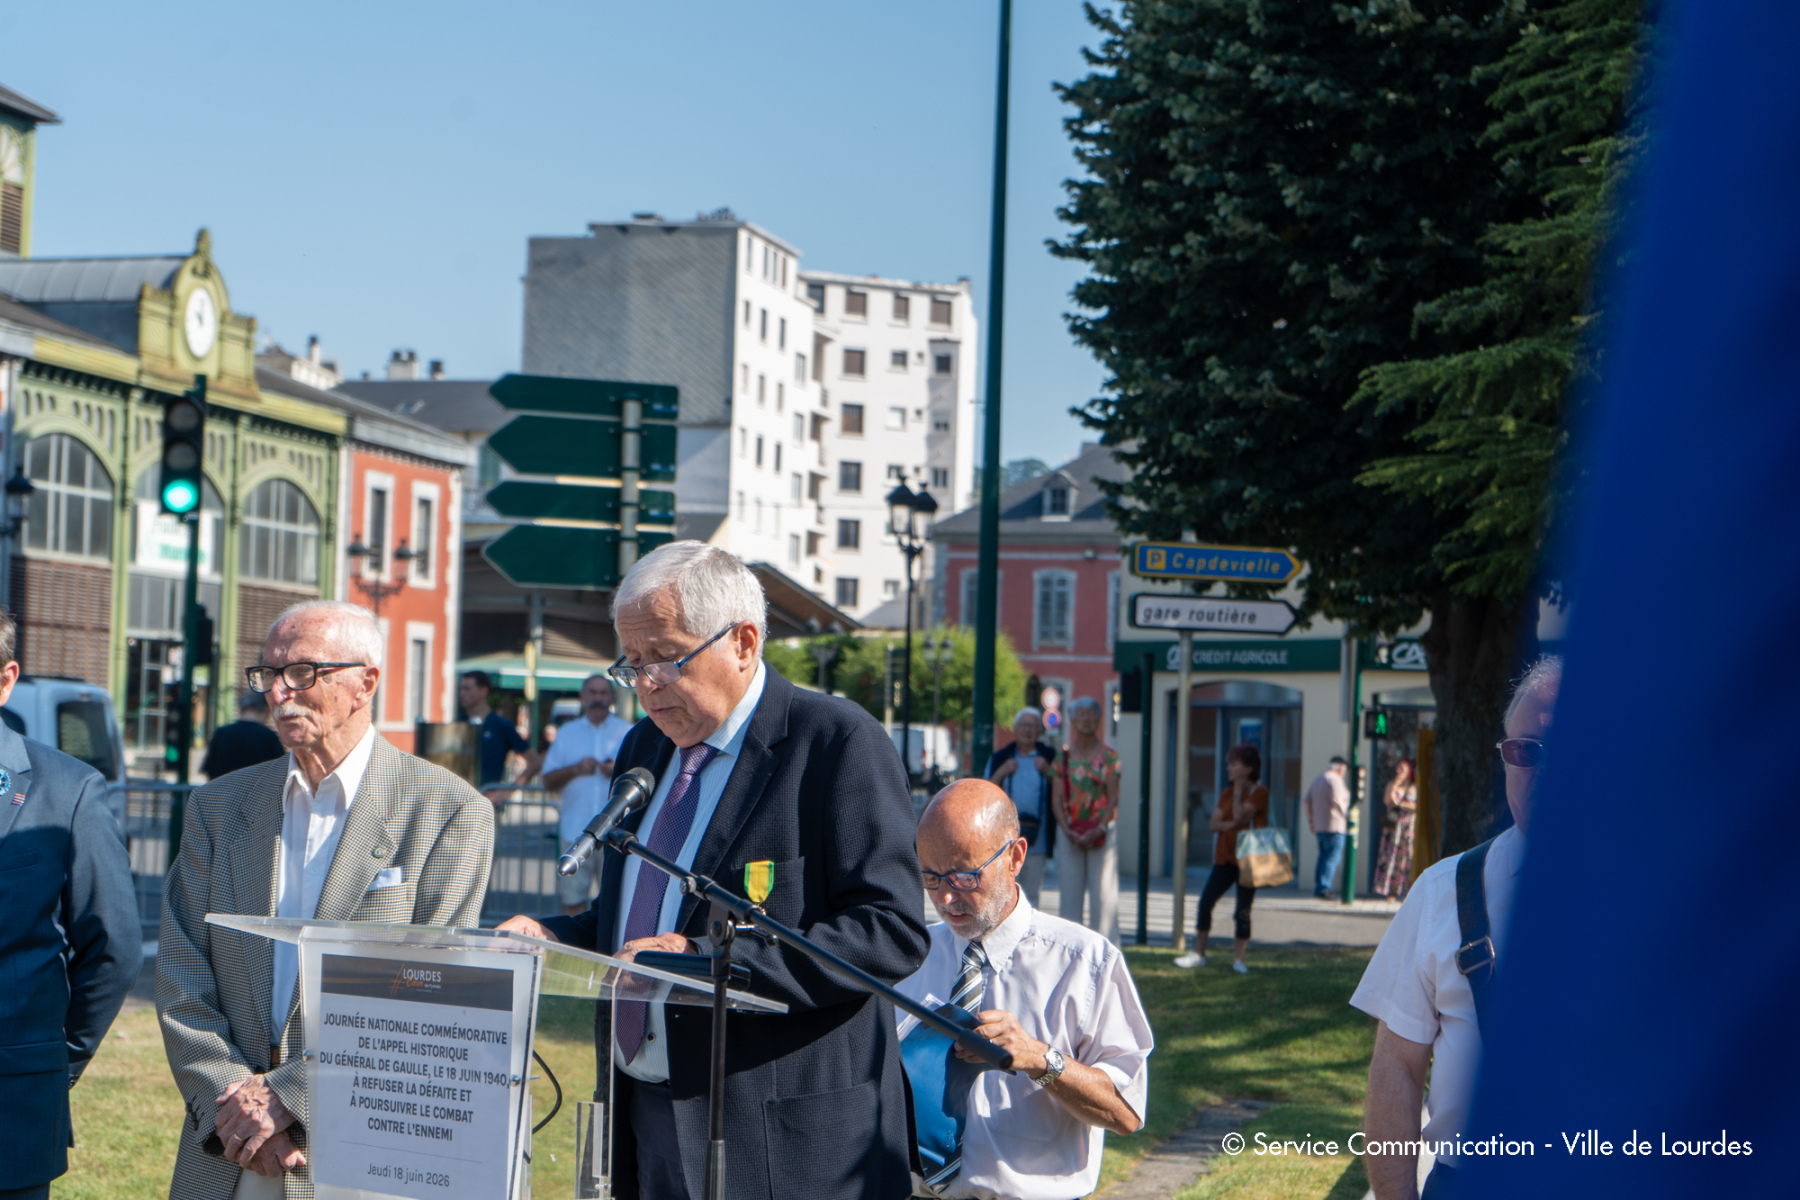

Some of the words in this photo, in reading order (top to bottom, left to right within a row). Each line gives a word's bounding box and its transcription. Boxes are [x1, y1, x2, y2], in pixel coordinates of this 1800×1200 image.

[1172, 552, 1280, 574] Capdevielle
[1143, 606, 1181, 624] gare
[1188, 608, 1257, 624] routière
[1233, 650, 1288, 665] AGRICOLE
[403, 968, 442, 983] LOURDES
[324, 1011, 366, 1029] JOURNÉE
[367, 1017, 419, 1035] NATIONALE
[421, 1022, 508, 1045] COMMÉMORATIVE
[358, 1036, 370, 1049] DE
[410, 1042, 469, 1063] HISTORIQUE
[320, 1051, 333, 1065] DU
[335, 1049, 376, 1070] GÉNÉRAL
[378, 1059, 390, 1072] DE
[392, 1060, 431, 1079] GAULLE,
[433, 1065, 444, 1078] LE
[446, 1066, 457, 1080] 18
[459, 1068, 482, 1083] JUIN
[483, 1071, 510, 1089] 1940,
[353, 1070, 360, 1088] À
[361, 1076, 404, 1094] REFUSER
[406, 1082, 417, 1096] LA
[419, 1080, 457, 1101] DÉFAITE
[460, 1089, 472, 1103] ET
[350, 1090, 357, 1108] À
[358, 1096, 418, 1116] POURSUIVRE
[420, 1104, 431, 1118] LE
[433, 1106, 474, 1124] COMBAT
[367, 1117, 405, 1134] CONTRE
[367, 1163, 392, 1178] Jeudi
[393, 1167, 404, 1180] 18
[404, 1168, 424, 1185] juin
[425, 1172, 450, 1187] 2026
